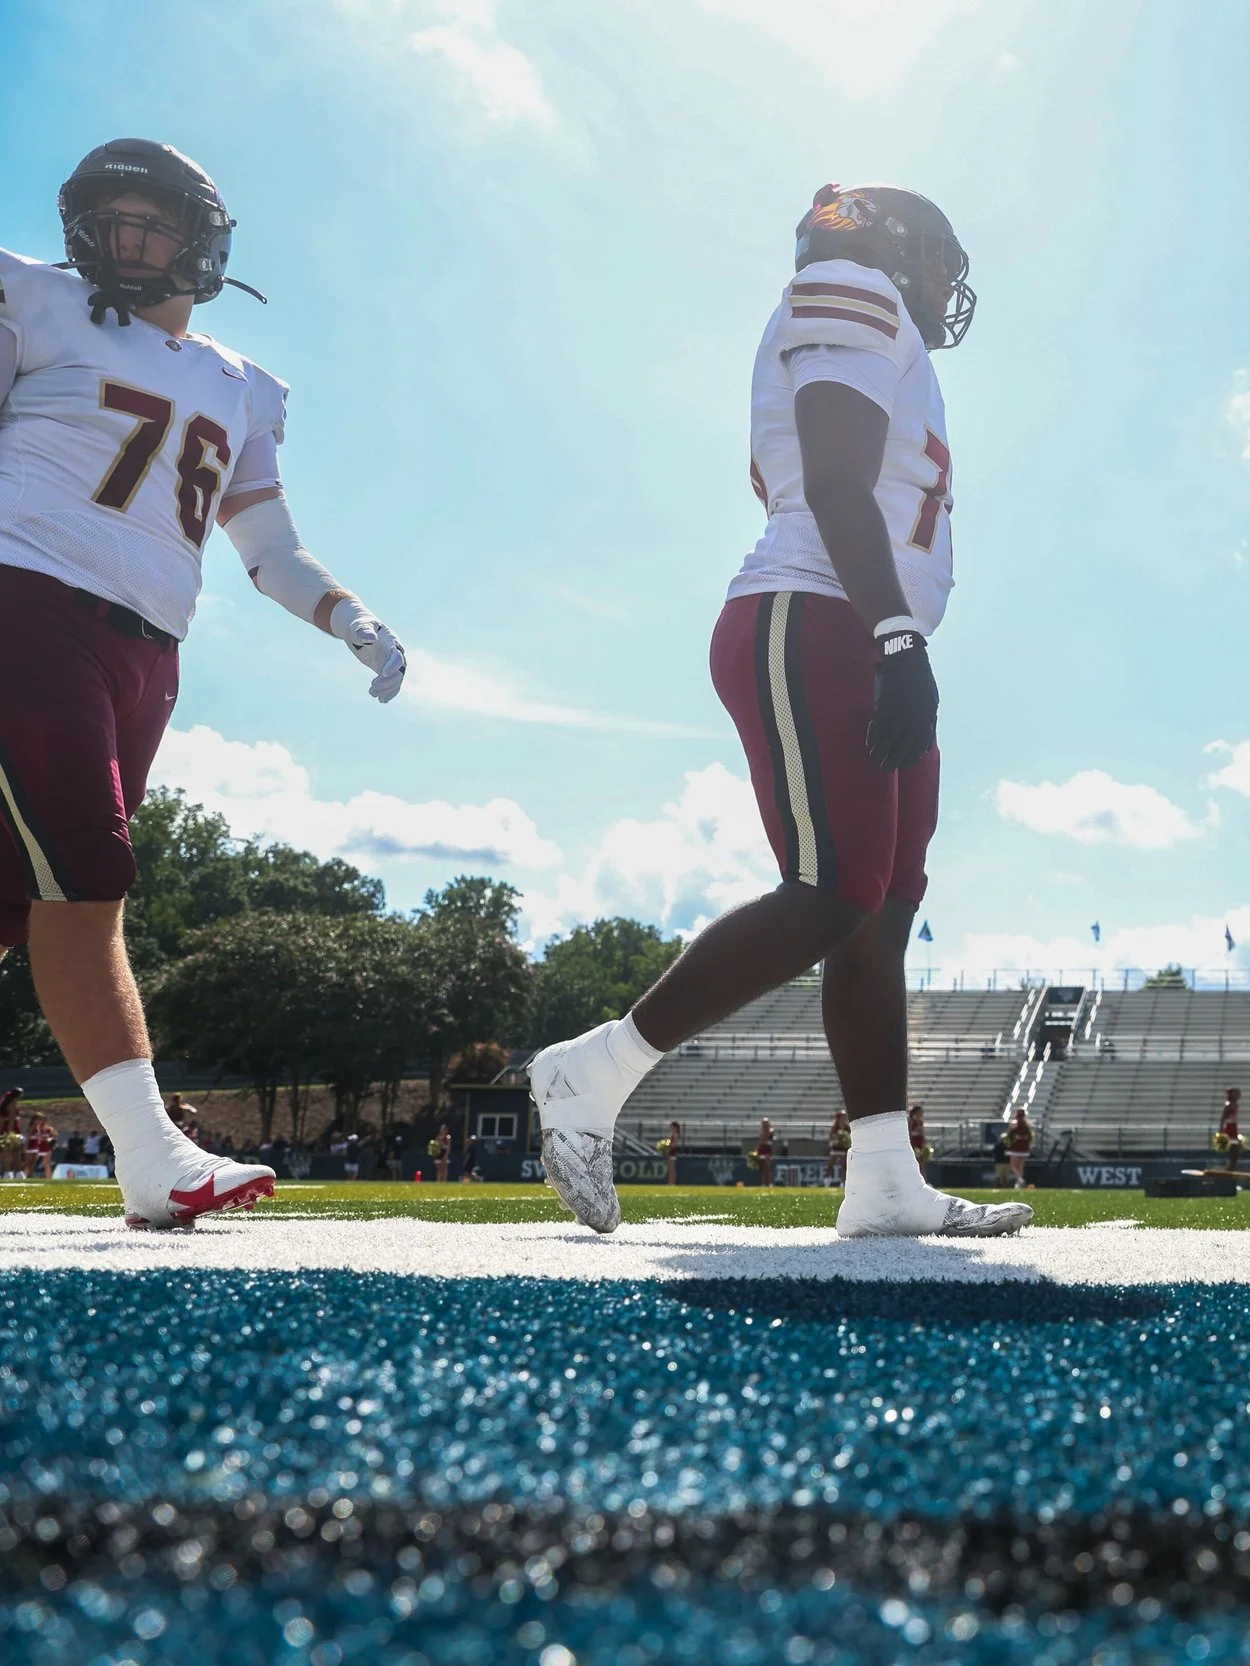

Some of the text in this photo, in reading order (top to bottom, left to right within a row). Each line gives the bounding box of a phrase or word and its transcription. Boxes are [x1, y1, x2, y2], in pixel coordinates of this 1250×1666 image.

[90, 376, 231, 553] 76
[906, 419, 954, 556] 7
[884, 634, 914, 655] NIKE
[1077, 1166, 1142, 1185] WEST
